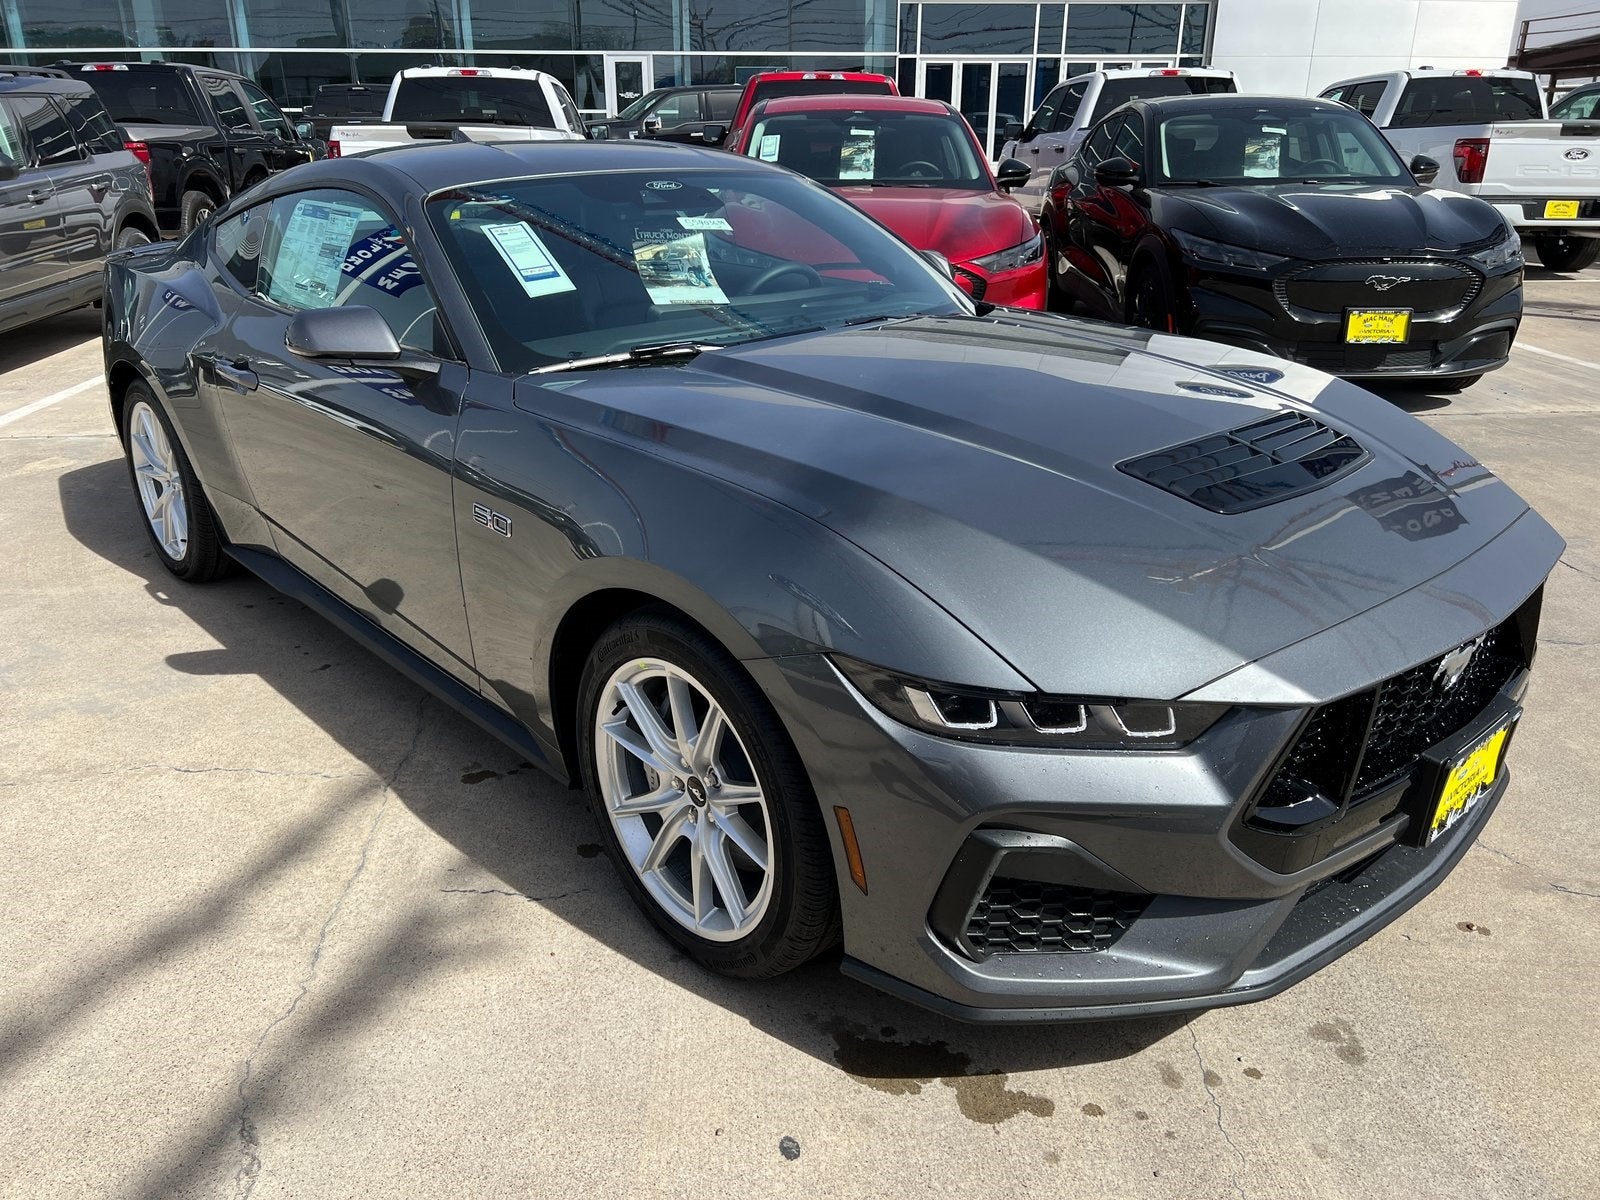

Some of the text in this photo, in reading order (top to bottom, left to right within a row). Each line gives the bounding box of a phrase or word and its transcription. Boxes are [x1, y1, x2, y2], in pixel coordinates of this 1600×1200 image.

[638, 231, 665, 239] TRUCK
[1363, 315, 1394, 324] MAC HAIK
[473, 502, 512, 538] 5.0
